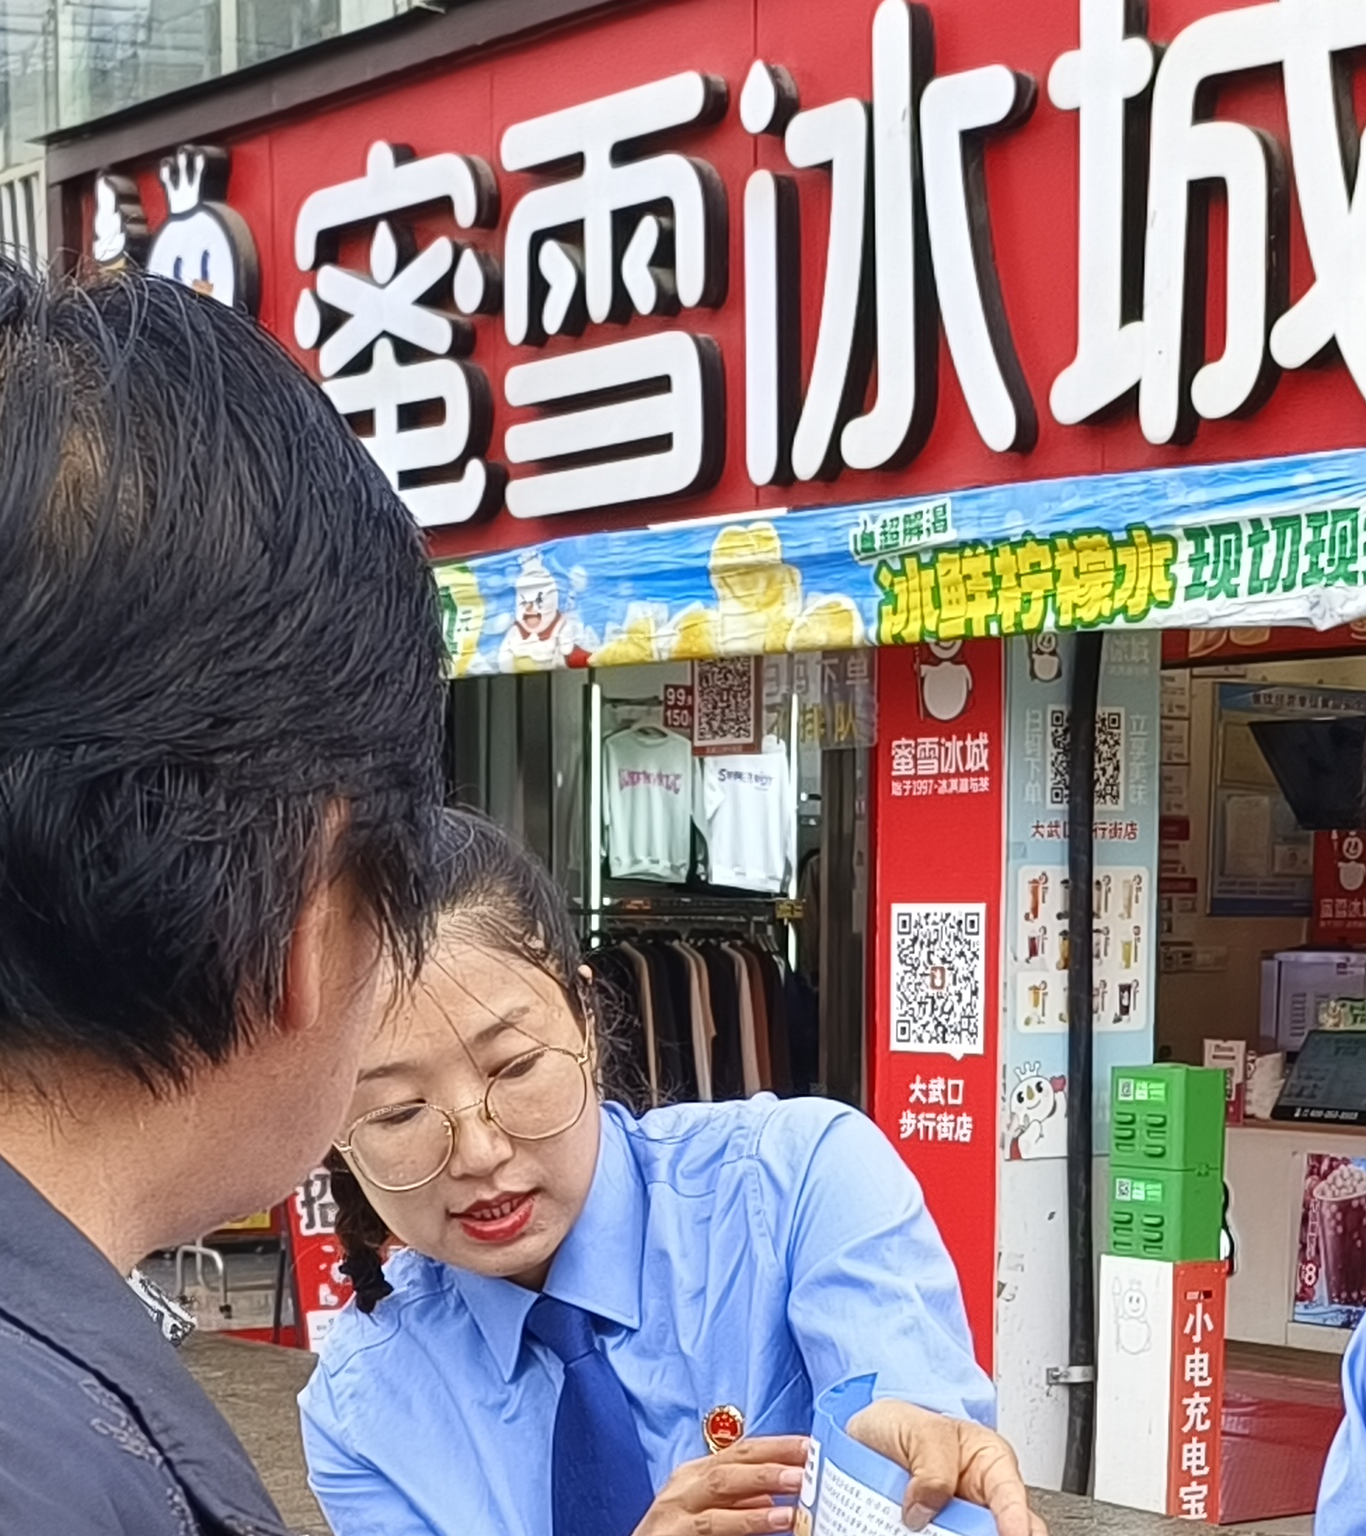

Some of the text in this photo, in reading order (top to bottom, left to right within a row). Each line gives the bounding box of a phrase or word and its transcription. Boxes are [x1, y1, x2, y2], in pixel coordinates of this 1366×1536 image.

[877, 524, 1177, 645] 冰鲜柠檬水
[891, 734, 989, 777] 蜜雪冰城
[908, 1075, 964, 1107] 大武口
[898, 1111, 973, 1145] 步行街店
[1176, 1303, 1214, 1521] 小电充电宝
